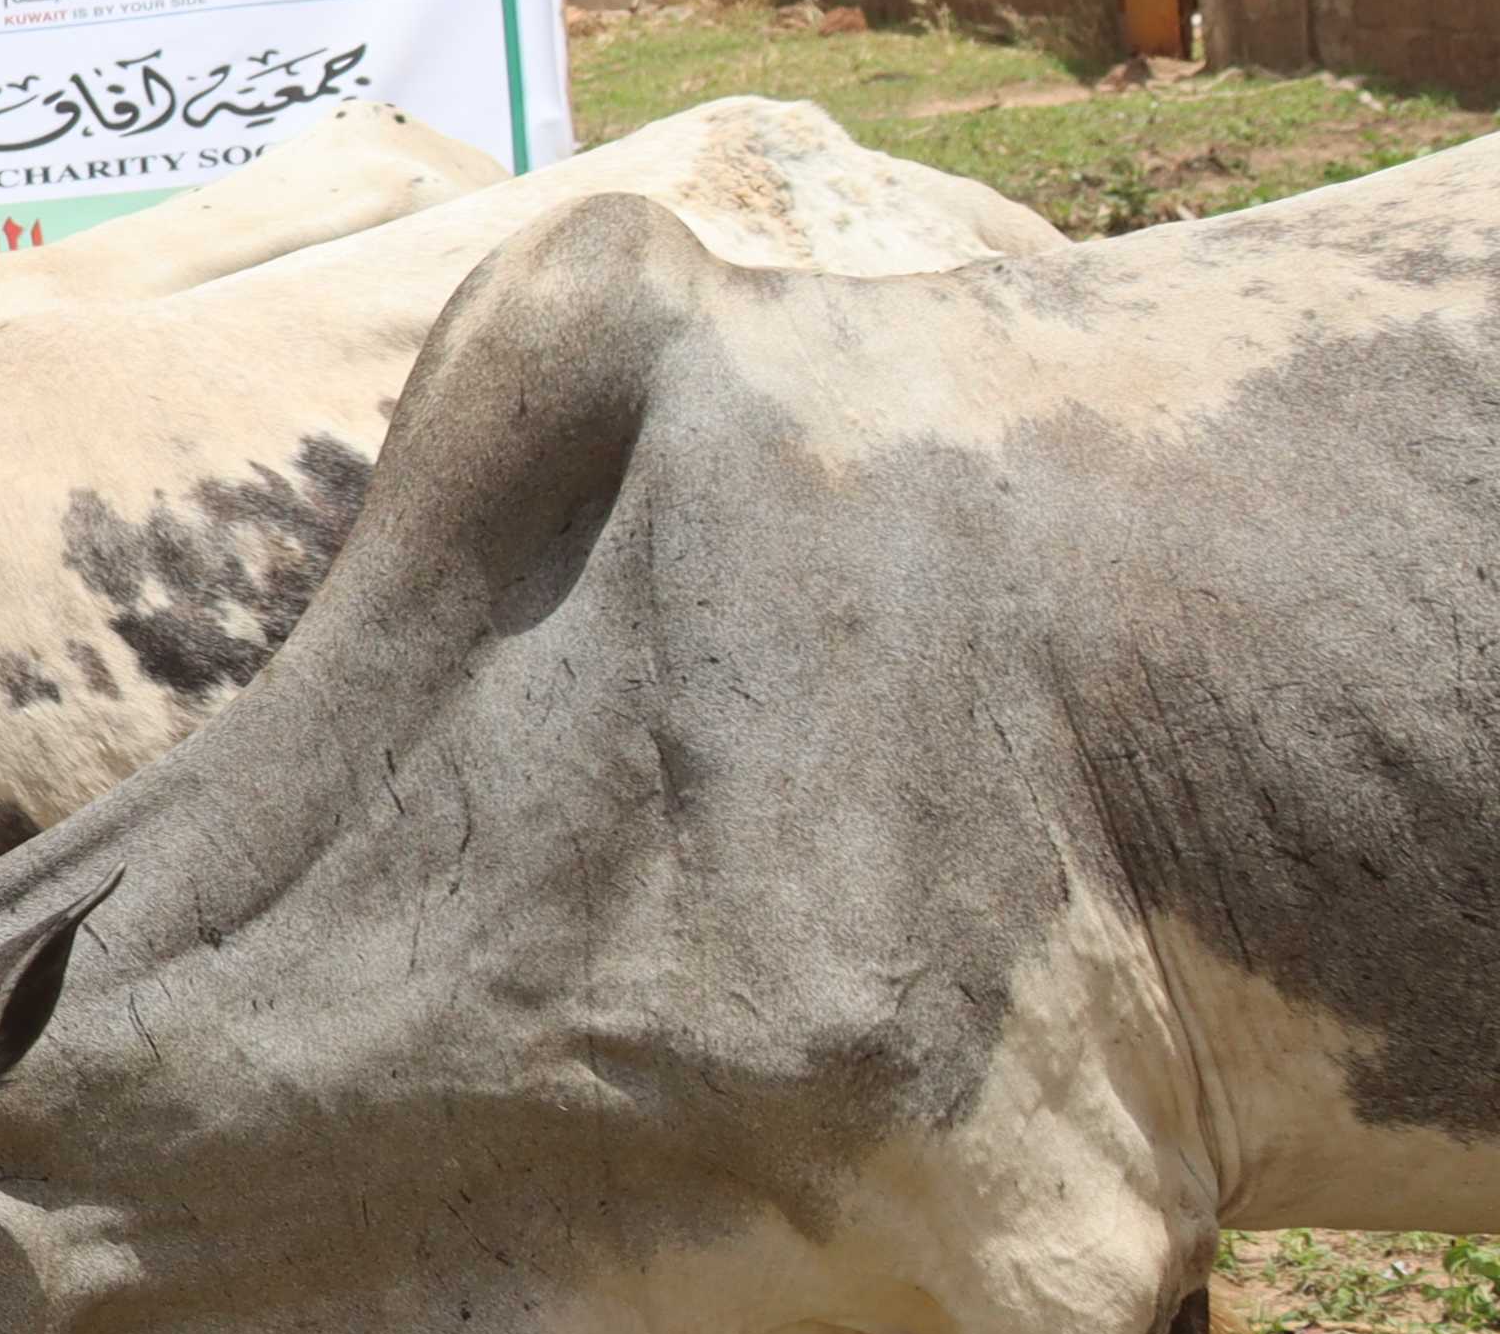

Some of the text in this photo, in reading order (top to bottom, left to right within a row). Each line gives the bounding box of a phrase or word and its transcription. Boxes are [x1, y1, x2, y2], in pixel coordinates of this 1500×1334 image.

[4, 10, 68, 26] KUWAIT
[73, 8, 88, 19] IS
[94, 4, 115, 17] BY
